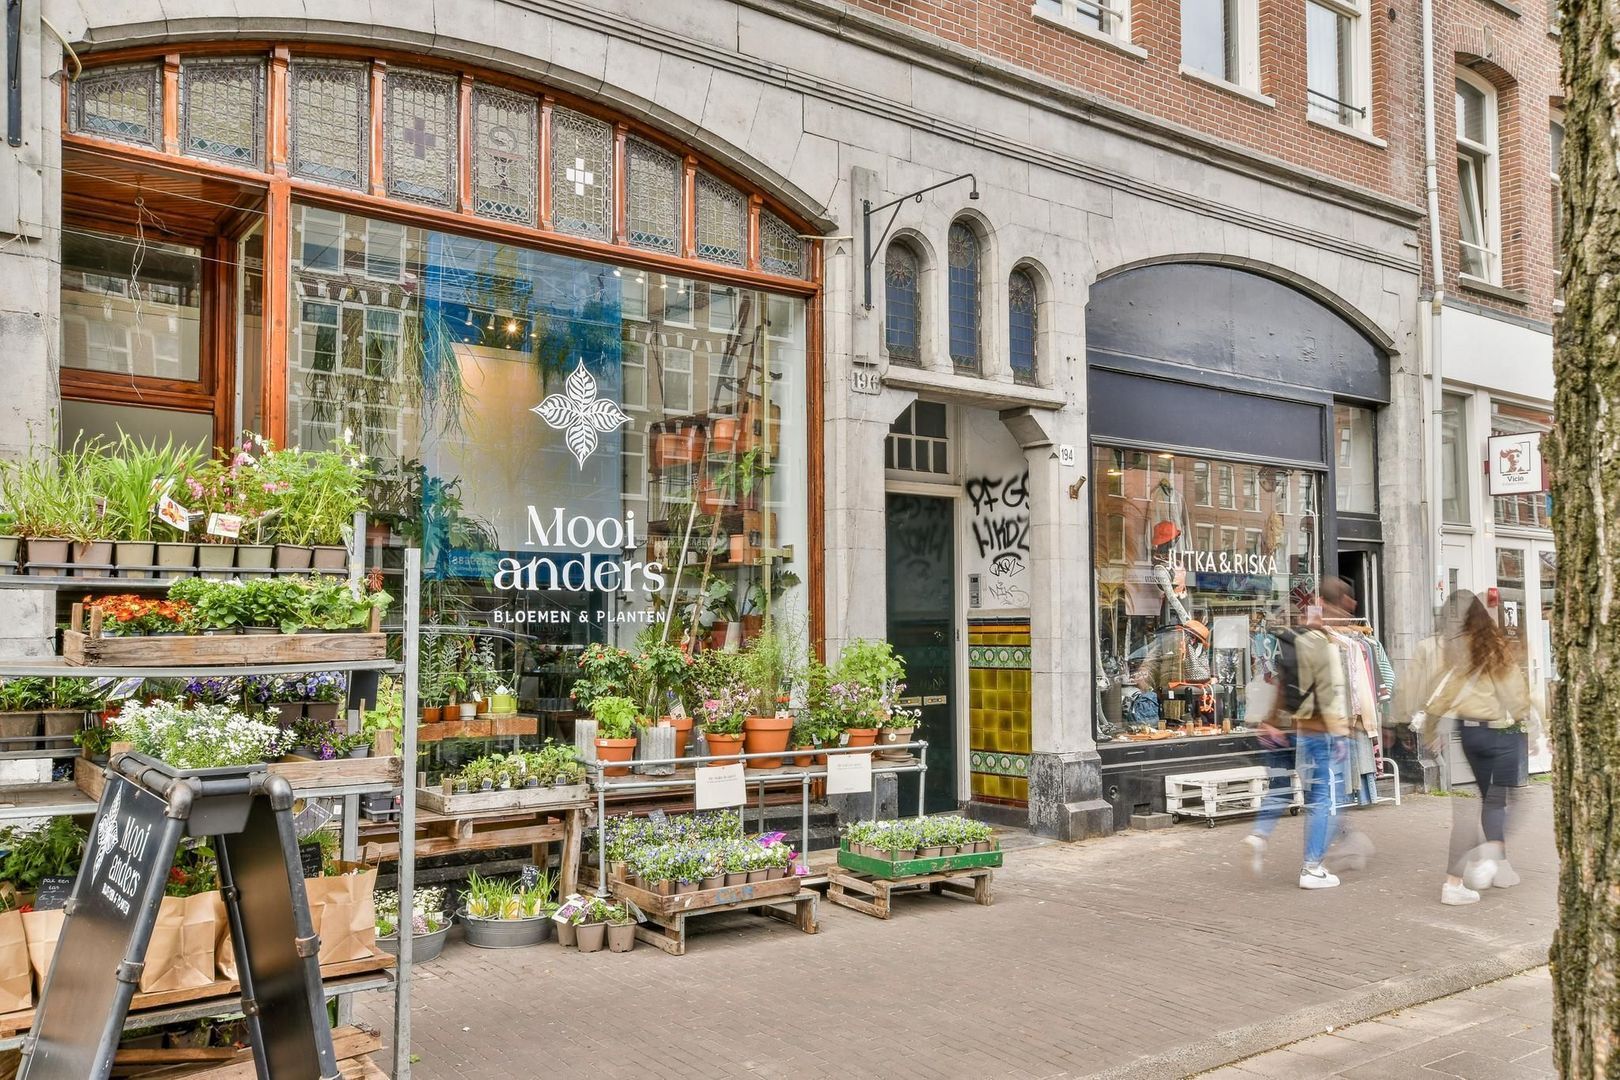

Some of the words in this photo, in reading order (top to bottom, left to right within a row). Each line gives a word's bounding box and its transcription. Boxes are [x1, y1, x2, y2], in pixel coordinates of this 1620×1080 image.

[853, 371, 880, 391] 196
[1061, 448, 1073, 462] 194
[525, 504, 638, 549] Mooi
[493, 552, 666, 593] anders
[1165, 548, 1217, 573] JUTKA
[1219, 551, 1233, 574] &
[1233, 552, 1279, 575] RISKA
[493, 610, 571, 624] BLOEMEN
[578, 610, 590, 624] &
[596, 610, 667, 624] PLANTEN
[119, 815, 152, 862] Mooi
[108, 853, 141, 898] anders
